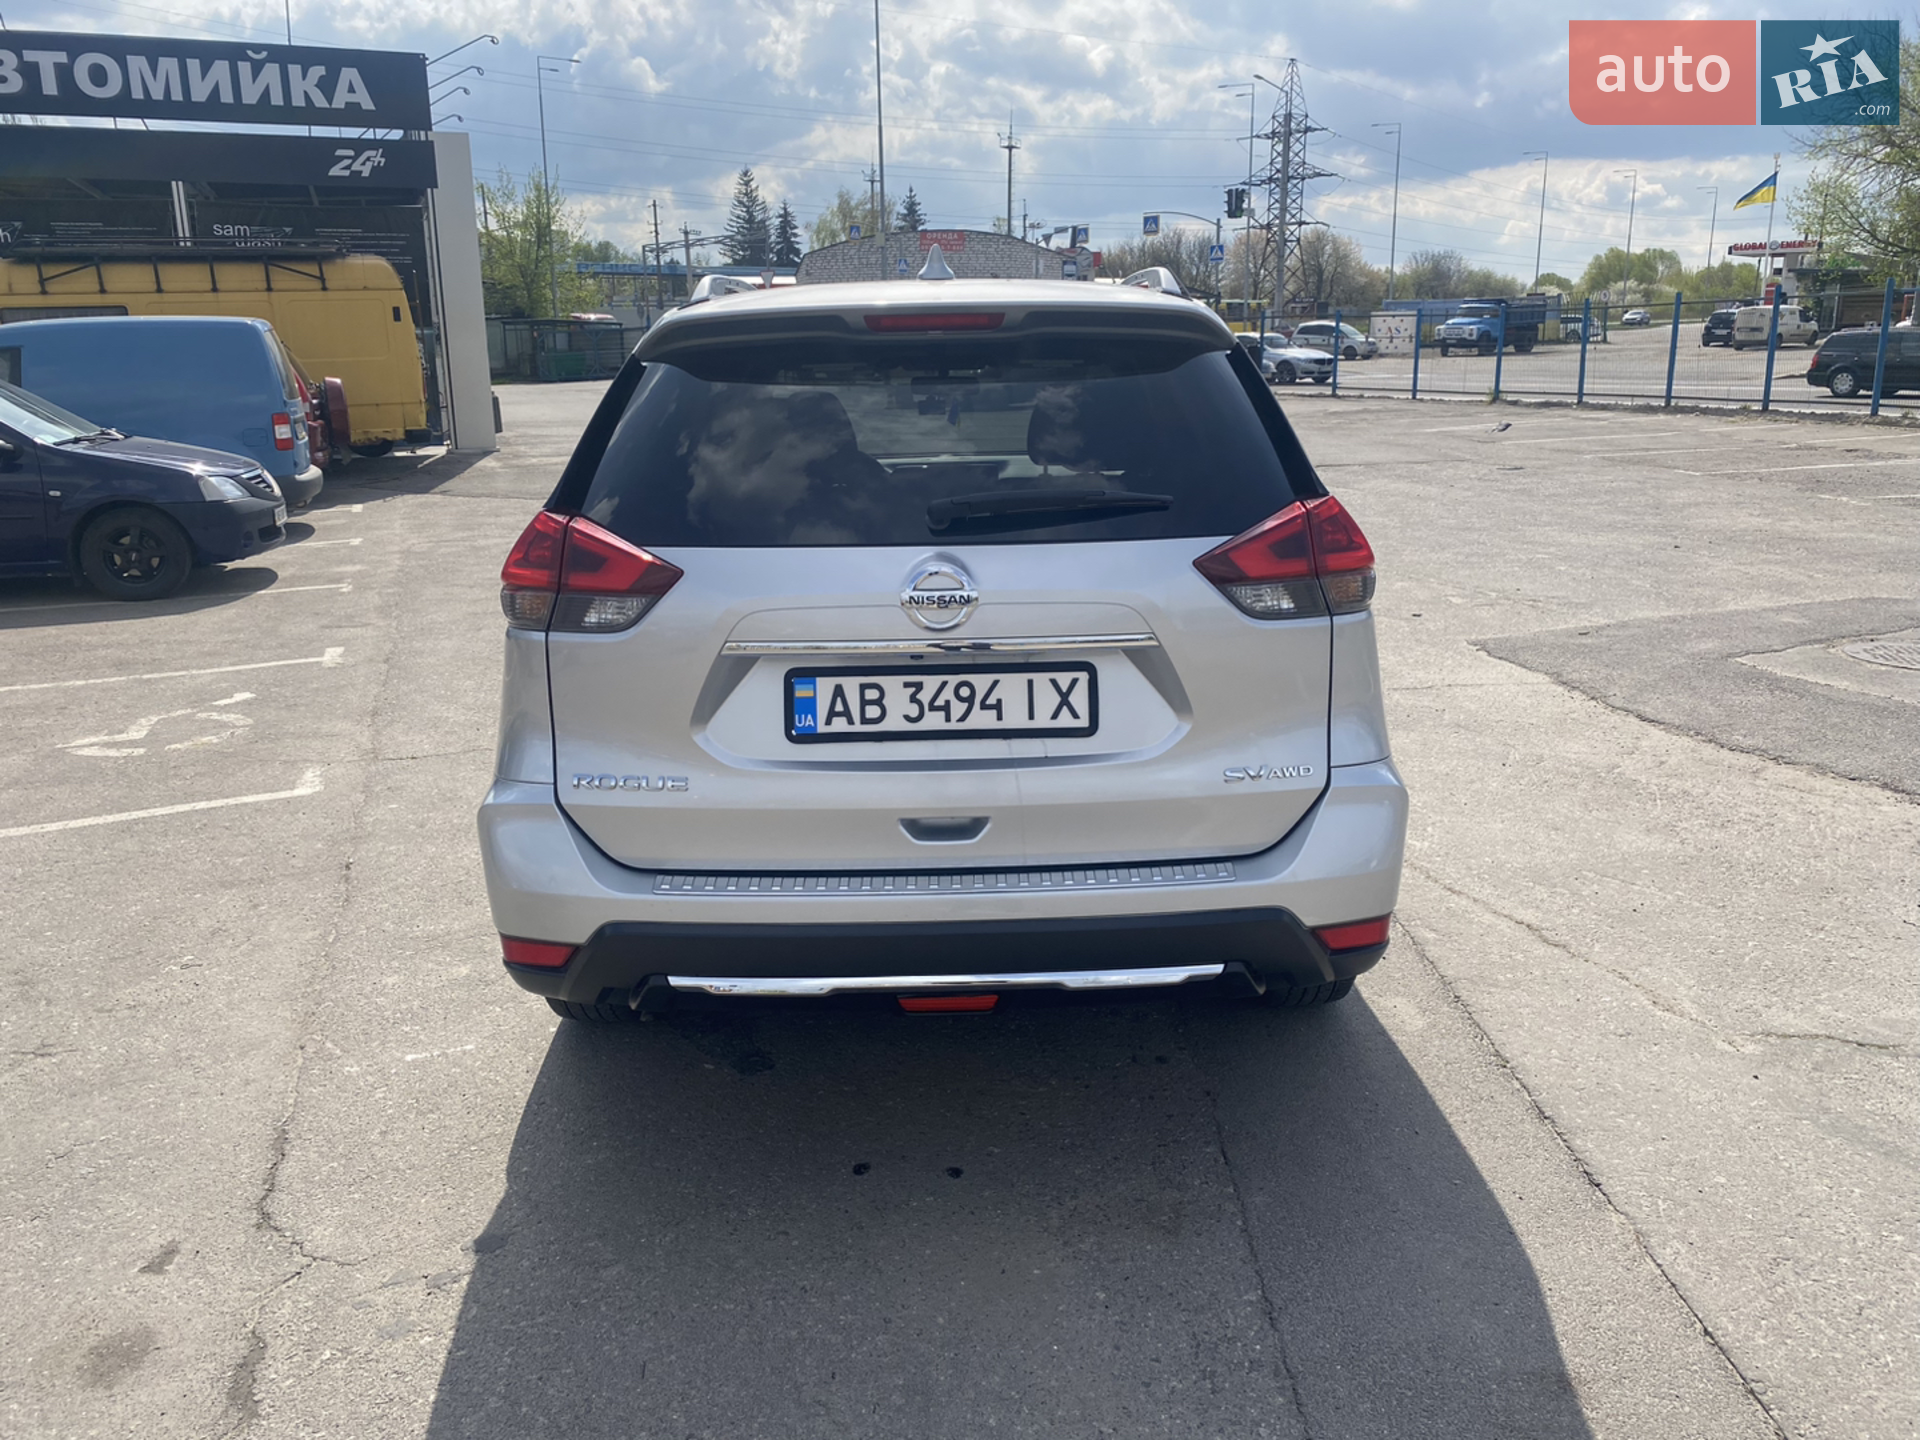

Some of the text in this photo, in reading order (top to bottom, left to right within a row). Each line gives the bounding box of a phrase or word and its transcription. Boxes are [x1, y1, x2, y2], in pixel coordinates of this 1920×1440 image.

[212, 223, 250, 236] sam
[926, 232, 959, 240] ОРЕНДА
[908, 594, 970, 606] NISSAN
[824, 682, 887, 726] AB
[902, 679, 1003, 723] 3494
[795, 714, 815, 728] UA
[572, 773, 689, 792] ROGUE
